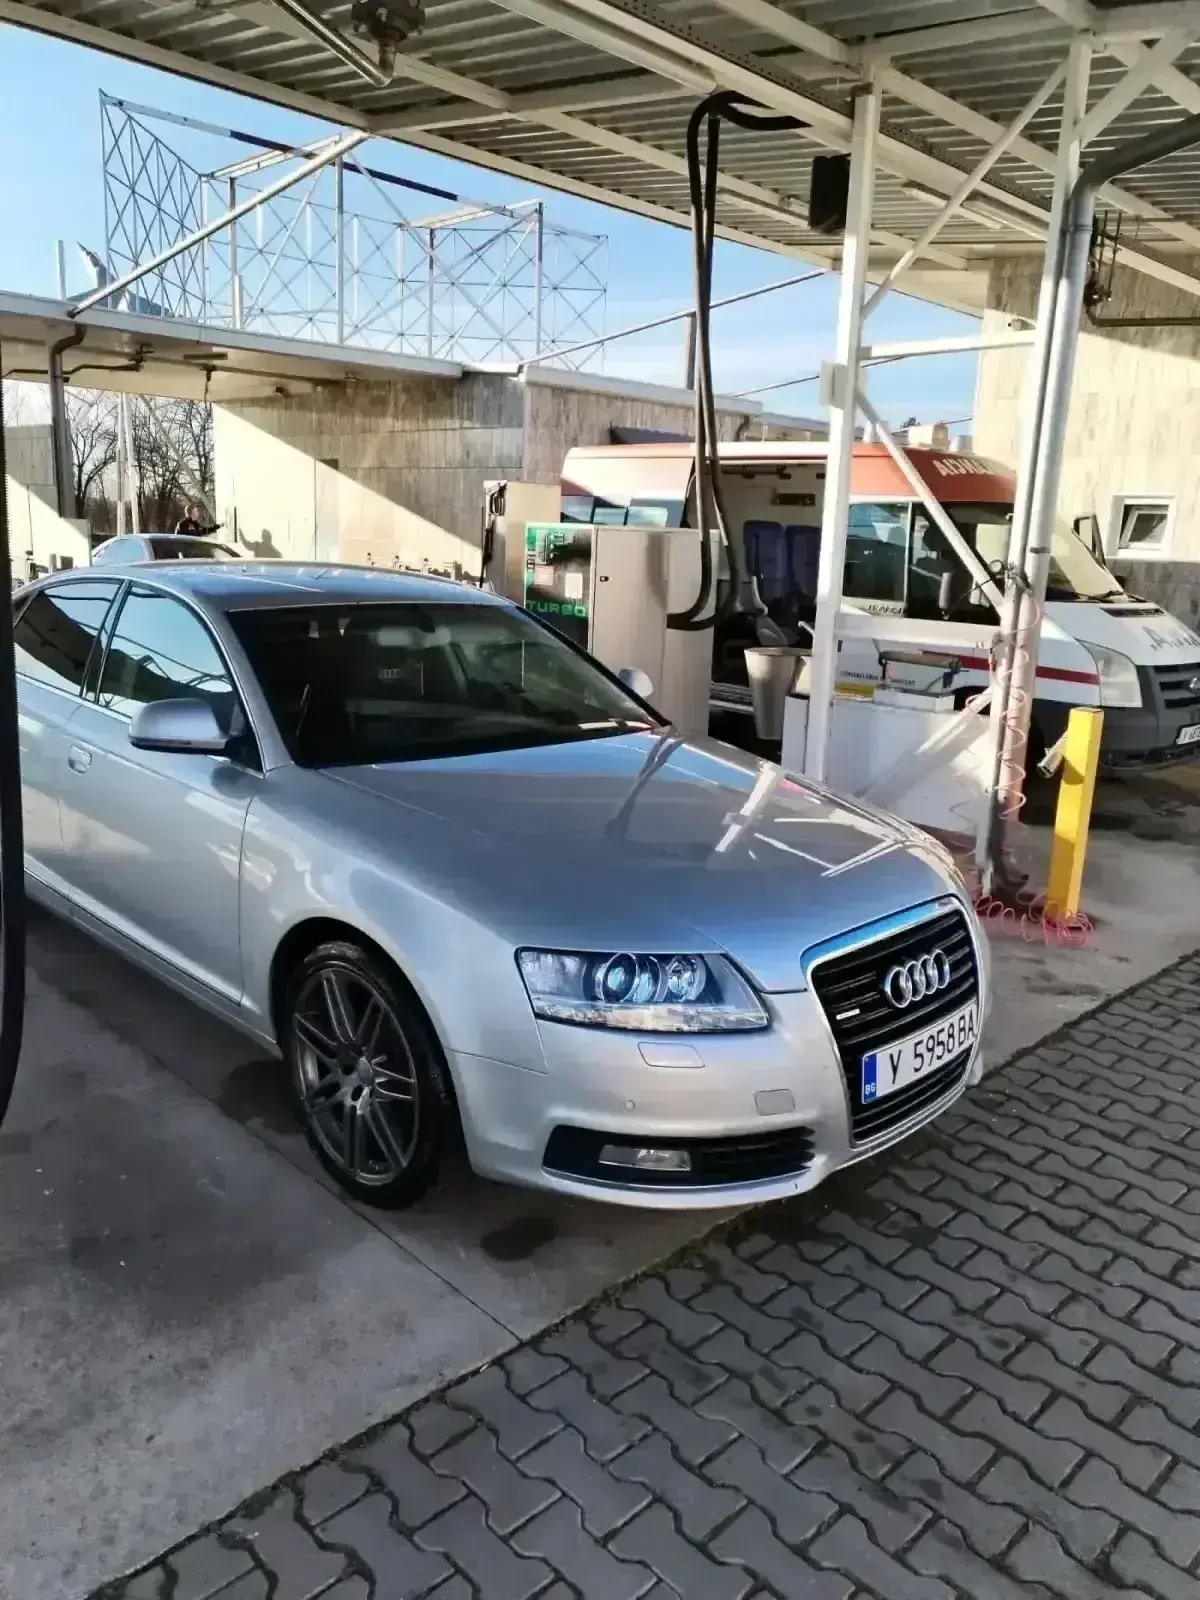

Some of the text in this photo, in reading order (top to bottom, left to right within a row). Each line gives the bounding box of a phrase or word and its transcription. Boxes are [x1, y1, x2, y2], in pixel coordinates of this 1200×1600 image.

[526, 600, 586, 617] TURBO
[889, 1049, 902, 1085] Y
[864, 1082, 876, 1096] BG
